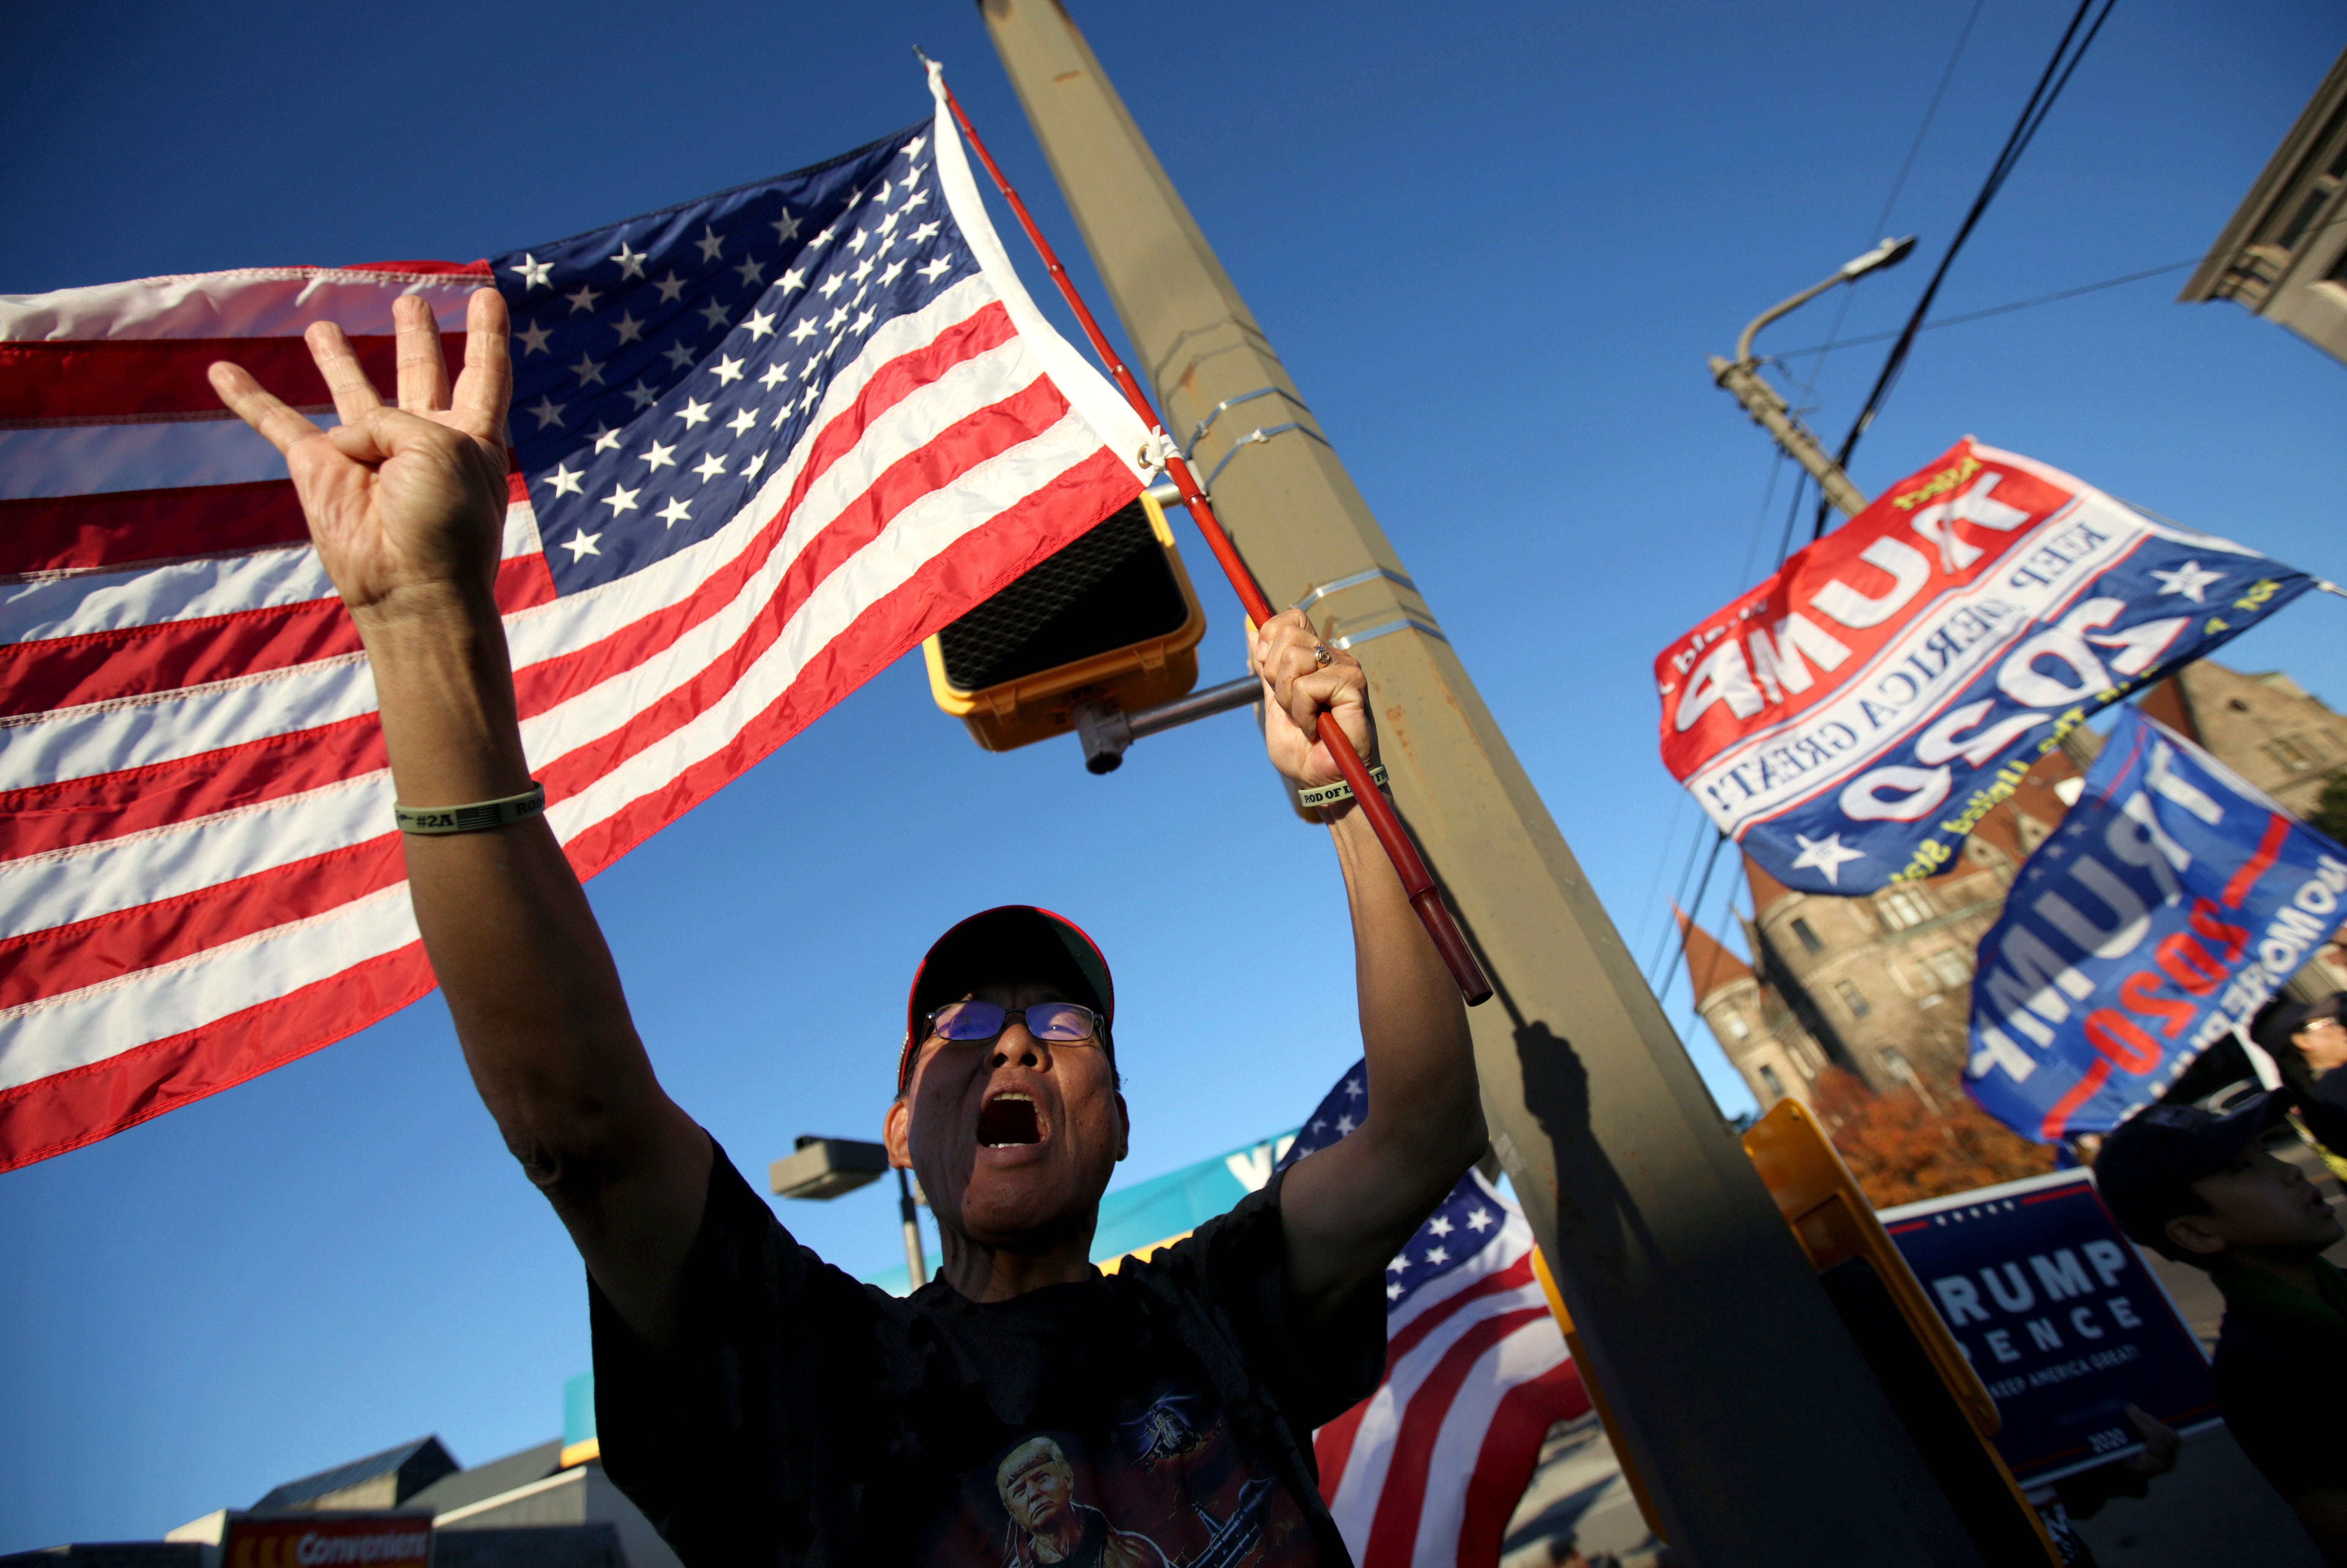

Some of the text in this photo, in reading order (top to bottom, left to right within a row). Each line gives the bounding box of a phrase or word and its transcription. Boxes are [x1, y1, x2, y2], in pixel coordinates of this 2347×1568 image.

[1304, 793, 1323, 803] ROD
[1325, 787, 1342, 800] OF
[416, 814, 454, 828] #2A
[1930, 1238, 2128, 1328] RUMP
